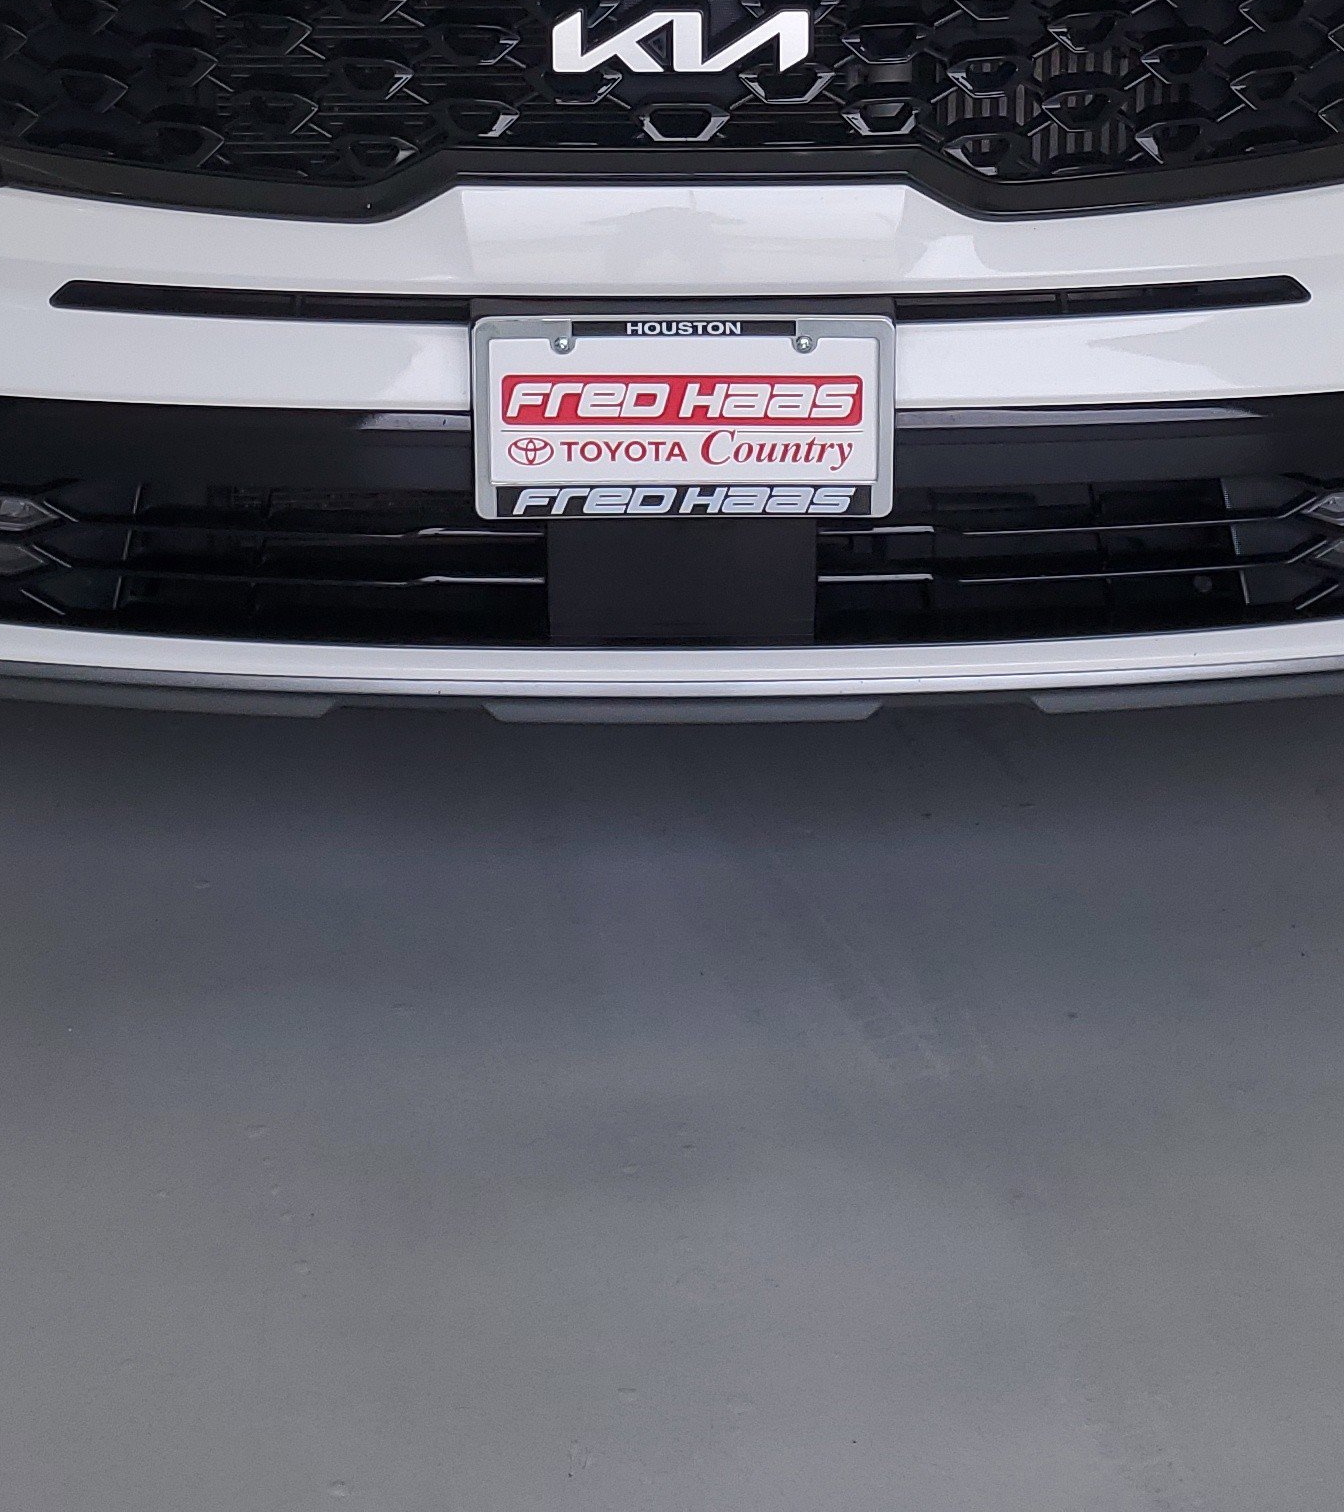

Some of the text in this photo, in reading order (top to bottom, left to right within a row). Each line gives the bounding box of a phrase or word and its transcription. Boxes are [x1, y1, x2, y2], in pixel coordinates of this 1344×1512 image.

[552, 9, 809, 73] KIA
[626, 321, 742, 335] HOUSTON
[560, 429, 854, 471] TOYOTA Country
